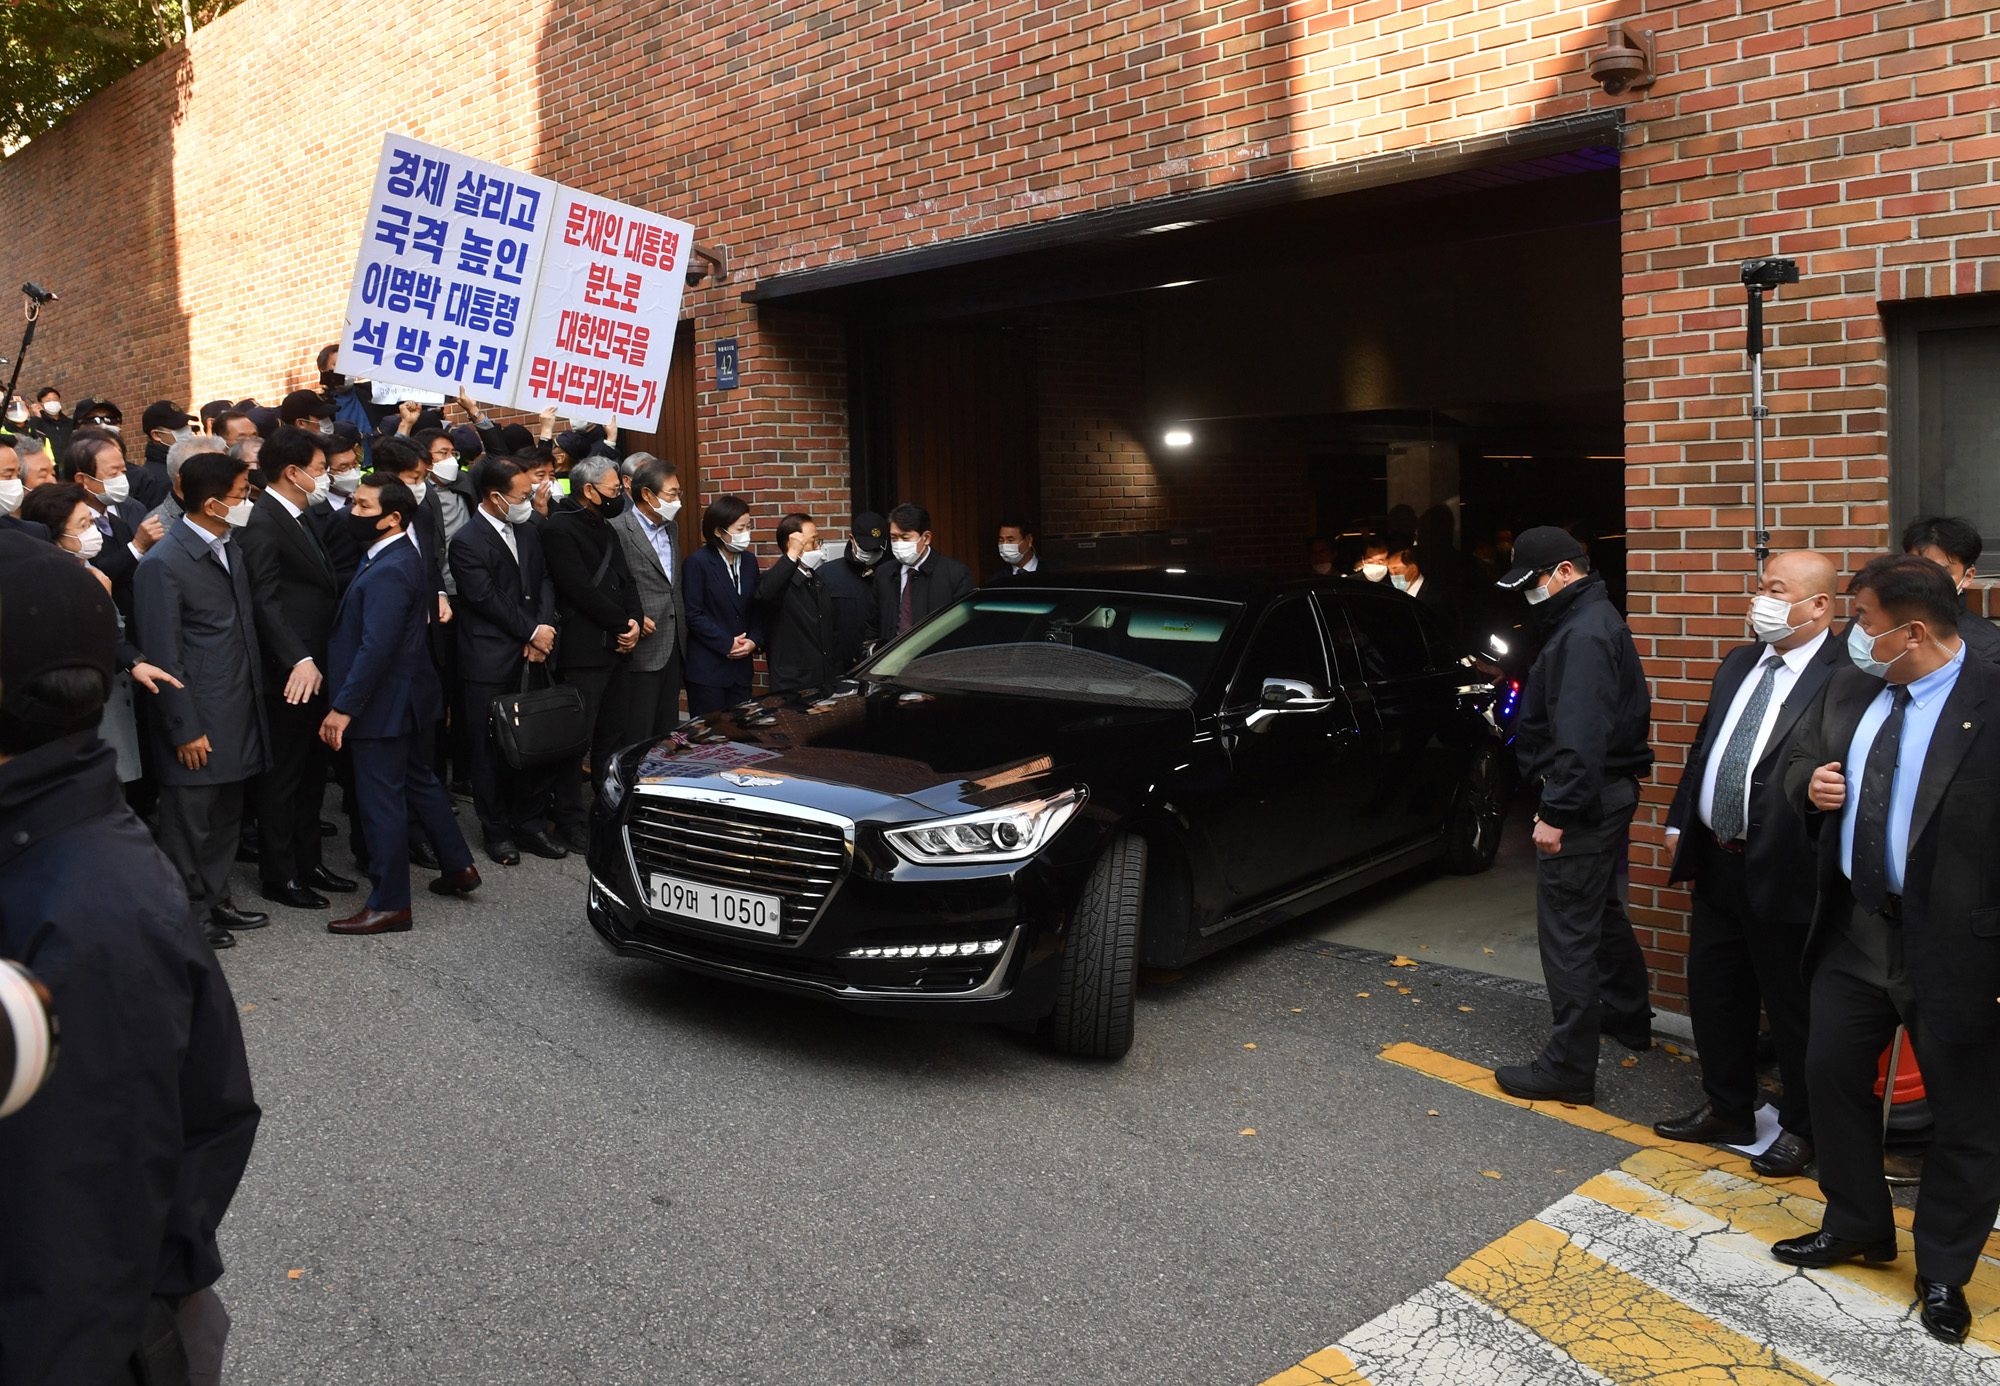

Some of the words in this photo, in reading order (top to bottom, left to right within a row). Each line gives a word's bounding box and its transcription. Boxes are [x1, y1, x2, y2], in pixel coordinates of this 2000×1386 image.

[387, 149, 450, 207] 경제
[454, 170, 541, 232] 살리고
[375, 204, 449, 265] 국격
[457, 227, 528, 285] 높인
[564, 202, 623, 256] 문재인
[624, 221, 680, 272] 대통령
[362, 262, 442, 320] 이명박
[444, 282, 520, 338] 대통령
[584, 262, 642, 314] 분노로
[352, 317, 509, 390] 석방하라
[556, 309, 650, 367] 대한민국을
[720, 354, 733, 375] 42
[528, 356, 658, 419] 무너뜨리려는가
[661, 882, 698, 914] 09머
[711, 892, 766, 927] 1050
